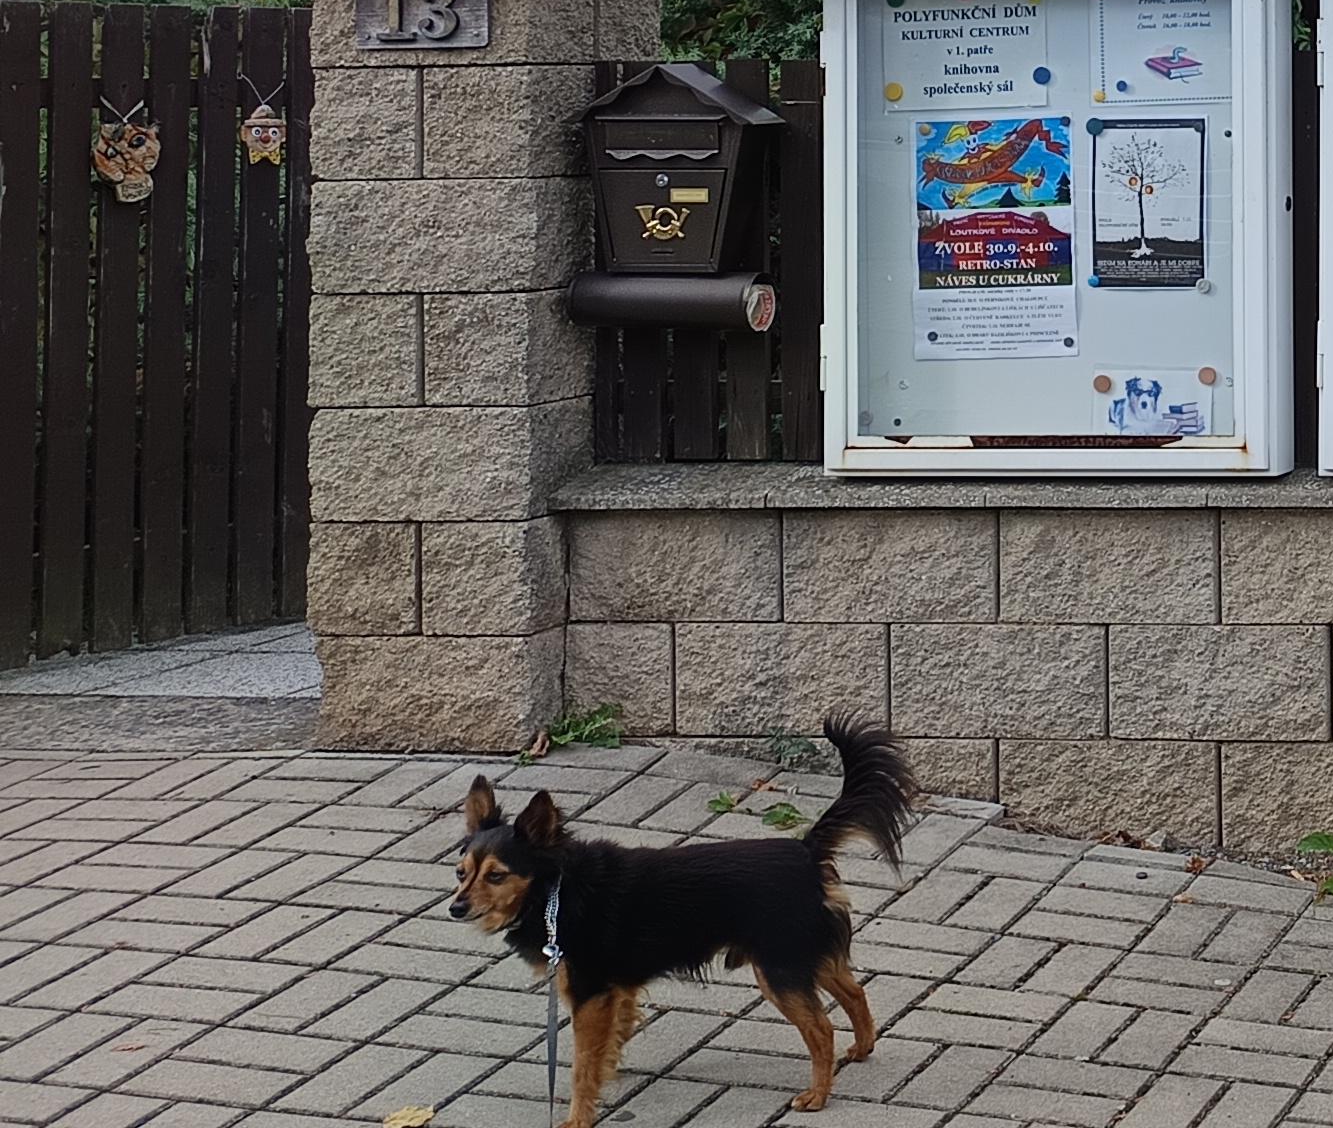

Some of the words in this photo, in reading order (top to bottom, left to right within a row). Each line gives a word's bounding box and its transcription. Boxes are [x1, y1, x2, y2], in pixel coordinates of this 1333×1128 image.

[893, 4, 997, 23] POLYFUNKČNÍ
[1003, 3, 1037, 18] DŮM
[901, 26, 964, 41] KULTURNÍ
[969, 25, 1030, 38] CENTRUM
[956, 46, 964, 55] 1.
[967, 44, 994, 57] patře
[944, 63, 1000, 76] knihovna
[923, 81, 994, 98] společenský
[997, 80, 1014, 92] sál
[949, 227, 996, 236] LOUTKOVÉ
[1001, 227, 1039, 235] DIVADLO
[934, 241, 984, 255] ZVOLE
[985, 241, 1059, 256] 30.9.-4.10.
[958, 258, 1037, 270] RETRO-STAN
[935, 274, 977, 287] NÁVES
[979, 274, 988, 286] U
[990, 272, 1061, 285] CUKRÁRNY
